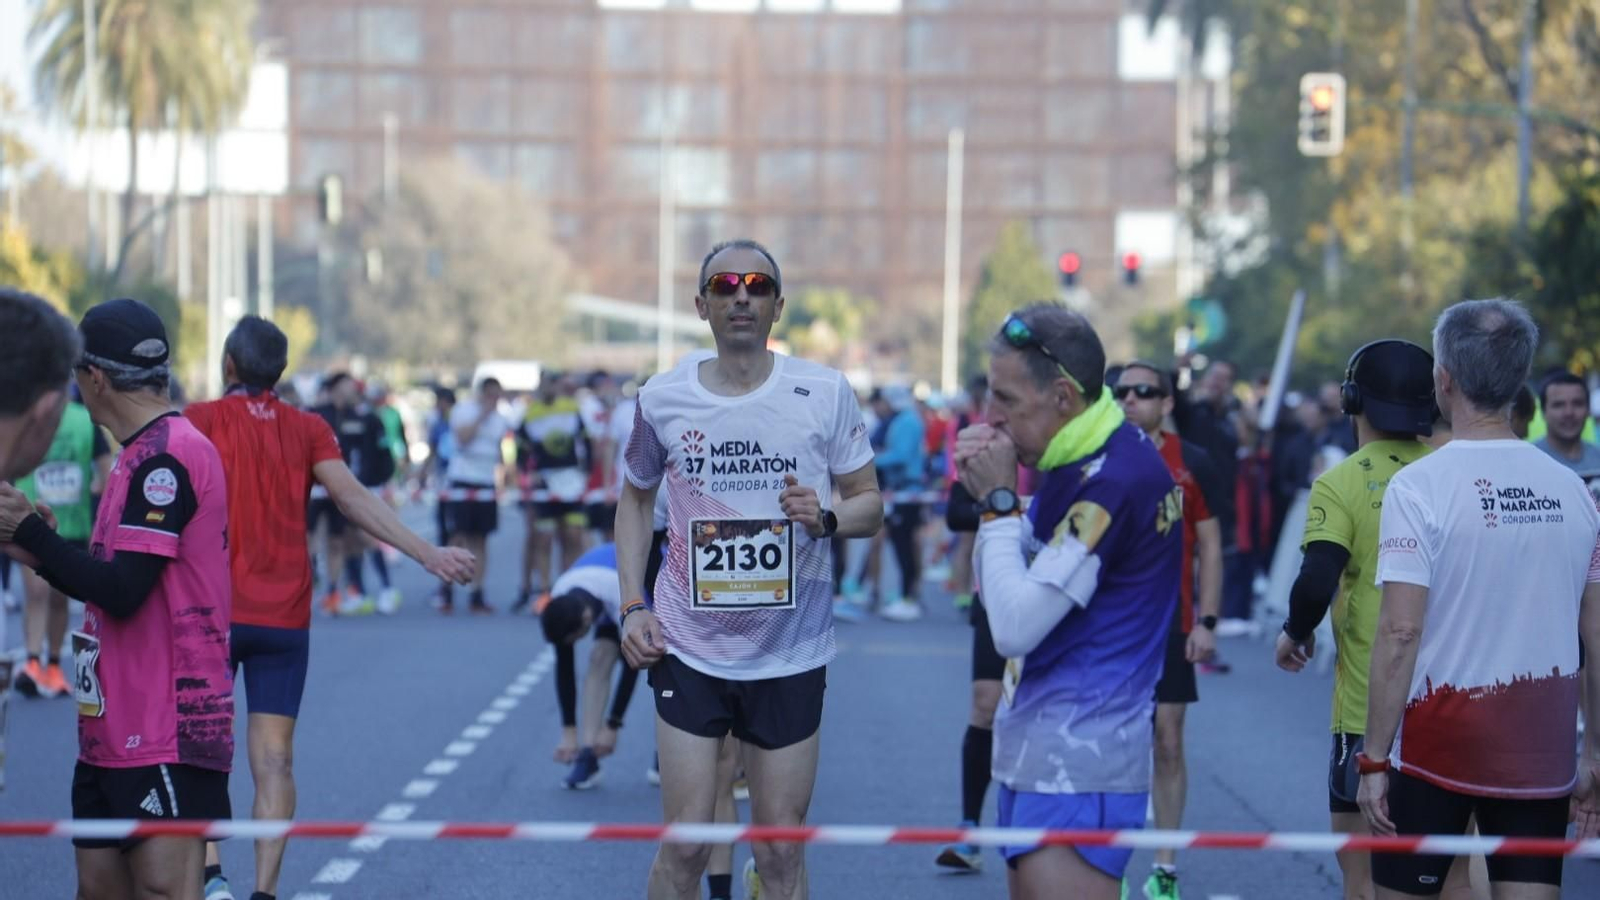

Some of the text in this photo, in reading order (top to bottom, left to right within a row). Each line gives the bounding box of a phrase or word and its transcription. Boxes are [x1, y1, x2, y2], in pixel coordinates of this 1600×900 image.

[710, 440, 763, 457] MEDIA
[685, 452, 797, 475] 37 MARATÓN
[711, 479, 786, 492] CÓRDOBA 20
[1496, 487, 1535, 499] MEDIA
[1480, 495, 1561, 512] 37 MARATÓN
[1502, 514, 1564, 524] CÓRDOBA 2023
[702, 543, 782, 571] 2130
[125, 735, 141, 749] 23
